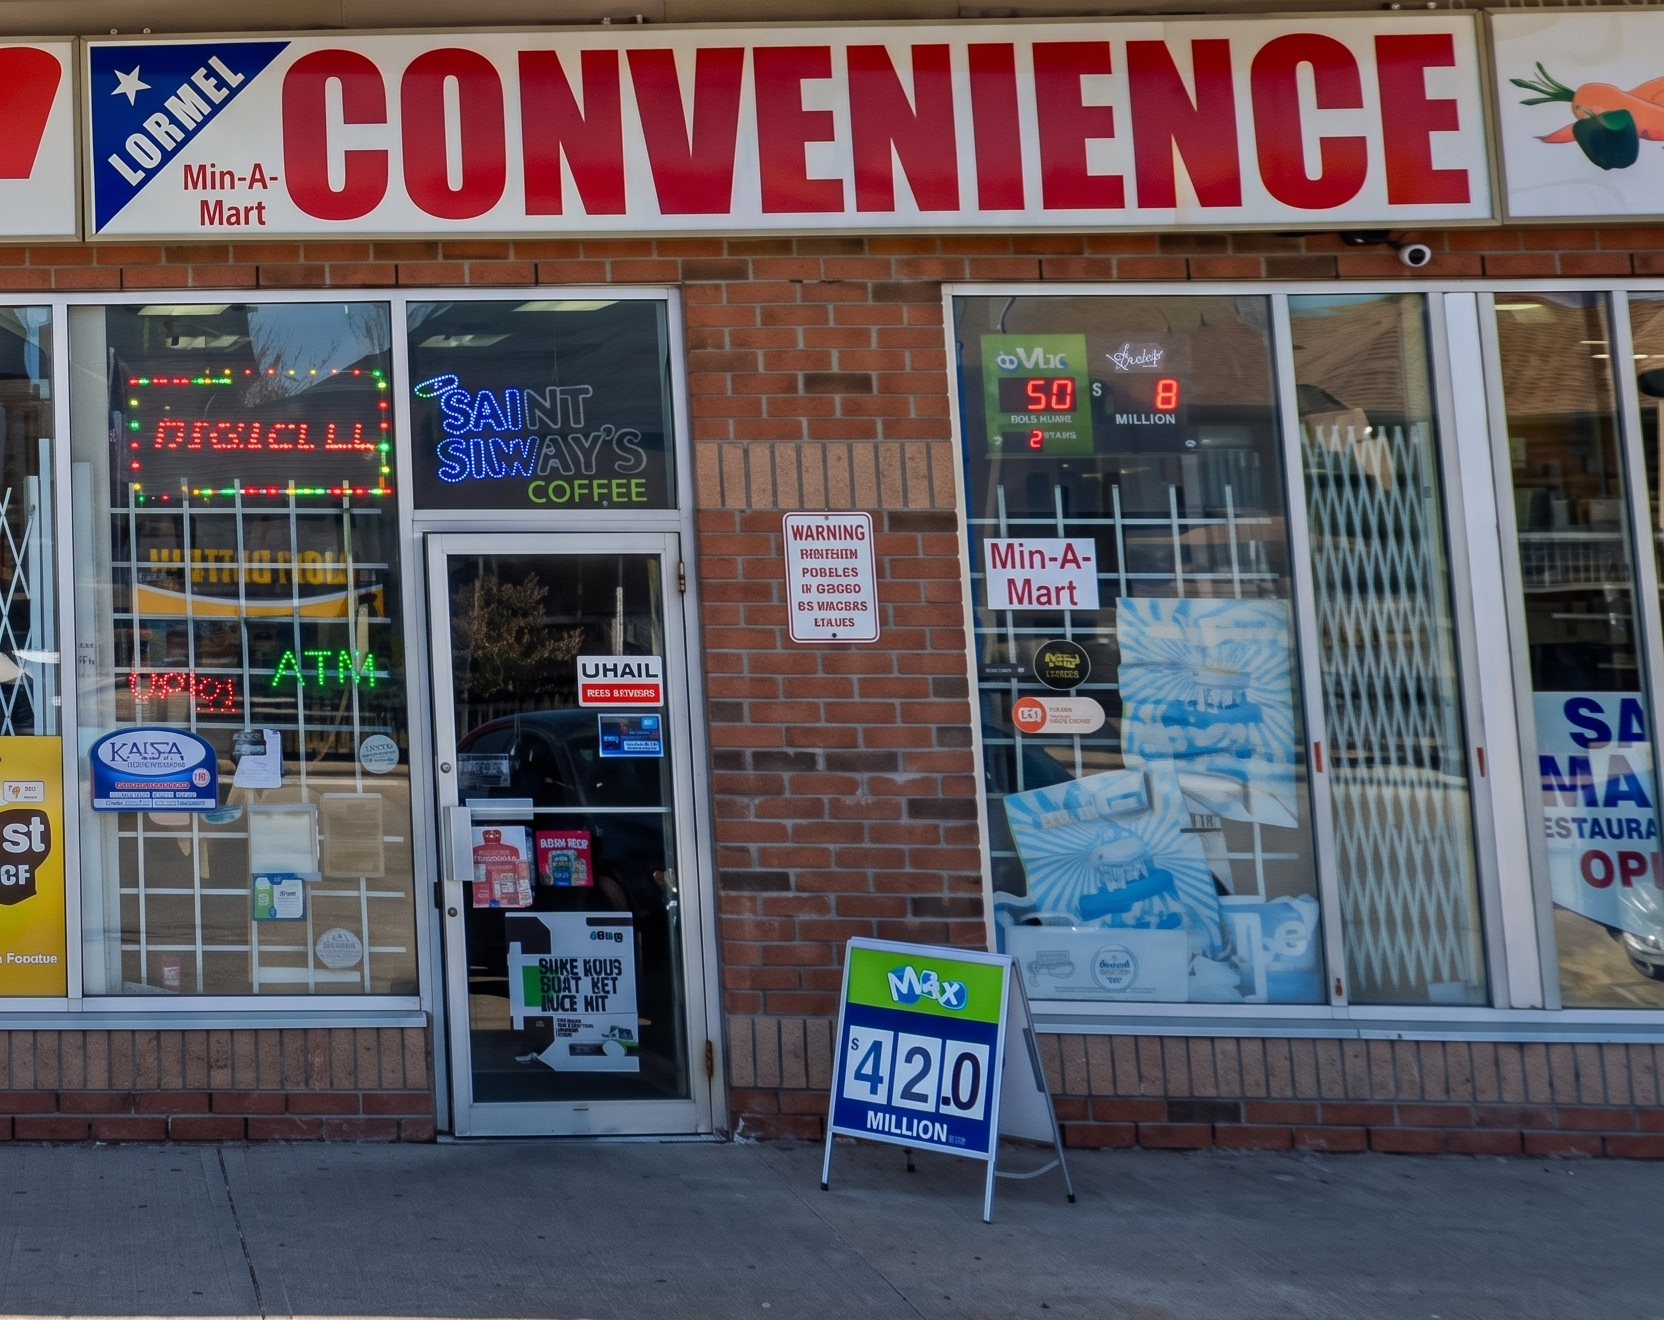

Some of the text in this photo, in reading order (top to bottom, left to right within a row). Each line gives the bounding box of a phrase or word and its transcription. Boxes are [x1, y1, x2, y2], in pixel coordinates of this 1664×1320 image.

[107, 55, 245, 187] LORMEL
[281, 32, 1471, 221] CONVENIENCE
[182, 164, 279, 191] Min-A-
[199, 199, 267, 227] Mart
[441, 384, 593, 434] SAINT
[1026, 379, 1073, 410] 50
[1156, 379, 1178, 410] 8
[1115, 414, 1176, 425] MILLION
[527, 479, 648, 504] COFFEE
[791, 524, 866, 542] WARNING
[990, 542, 1092, 570] Min-A-
[1006, 578, 1079, 606] Mart
[271, 650, 376, 688] ATM
[866, 1110, 948, 1143] MILLION
